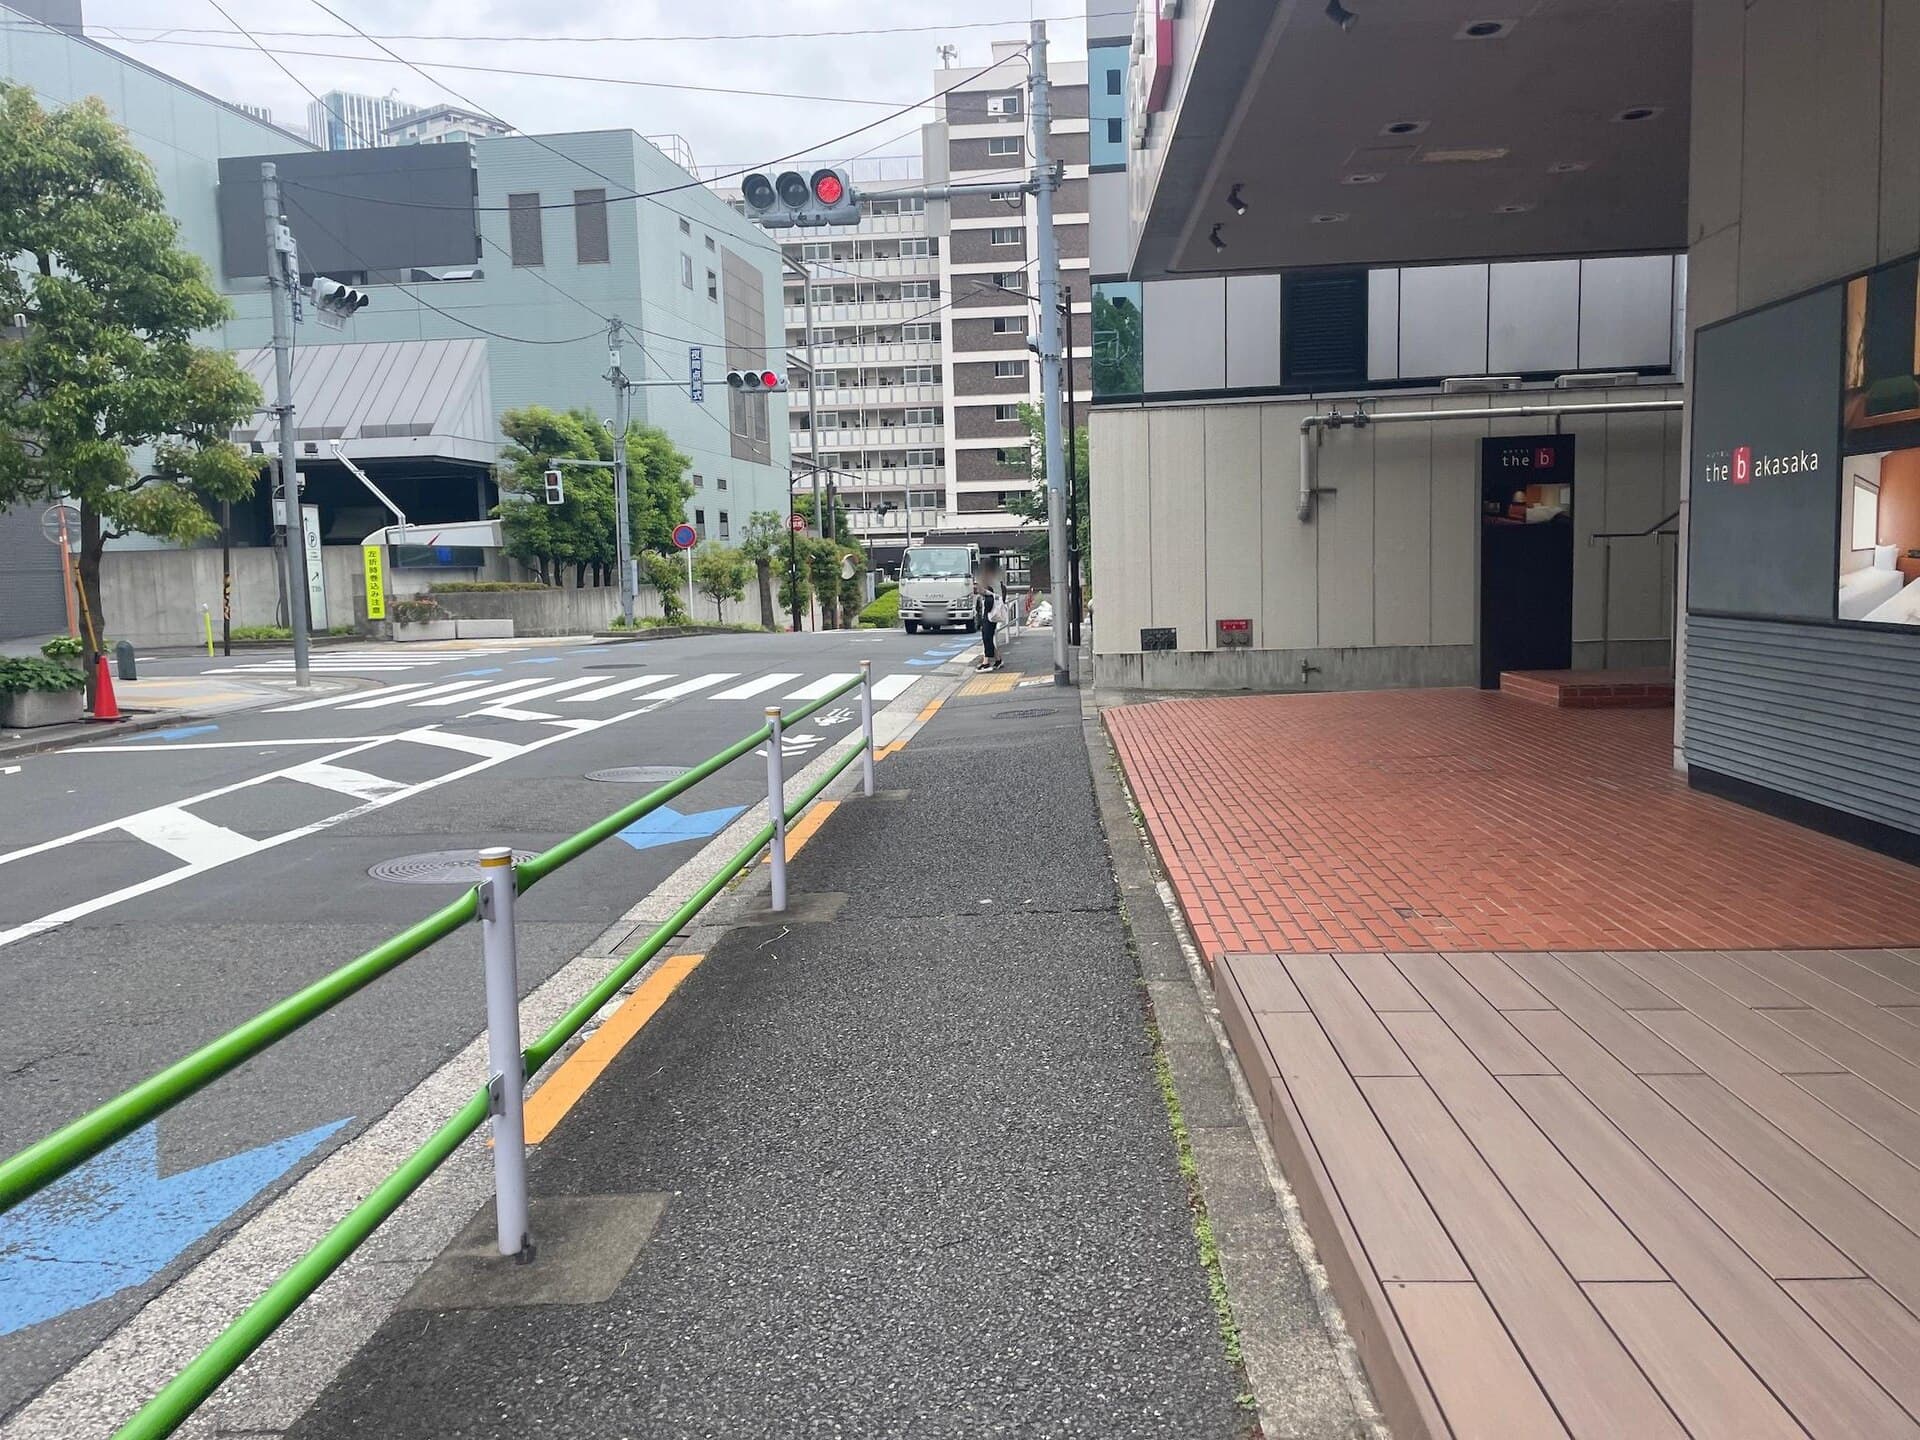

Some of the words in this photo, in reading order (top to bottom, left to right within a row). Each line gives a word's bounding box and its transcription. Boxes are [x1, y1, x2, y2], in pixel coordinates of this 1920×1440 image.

[1502, 456, 1530, 466] the
[1705, 462, 1728, 483] the
[1754, 449, 1819, 478] akasaka
